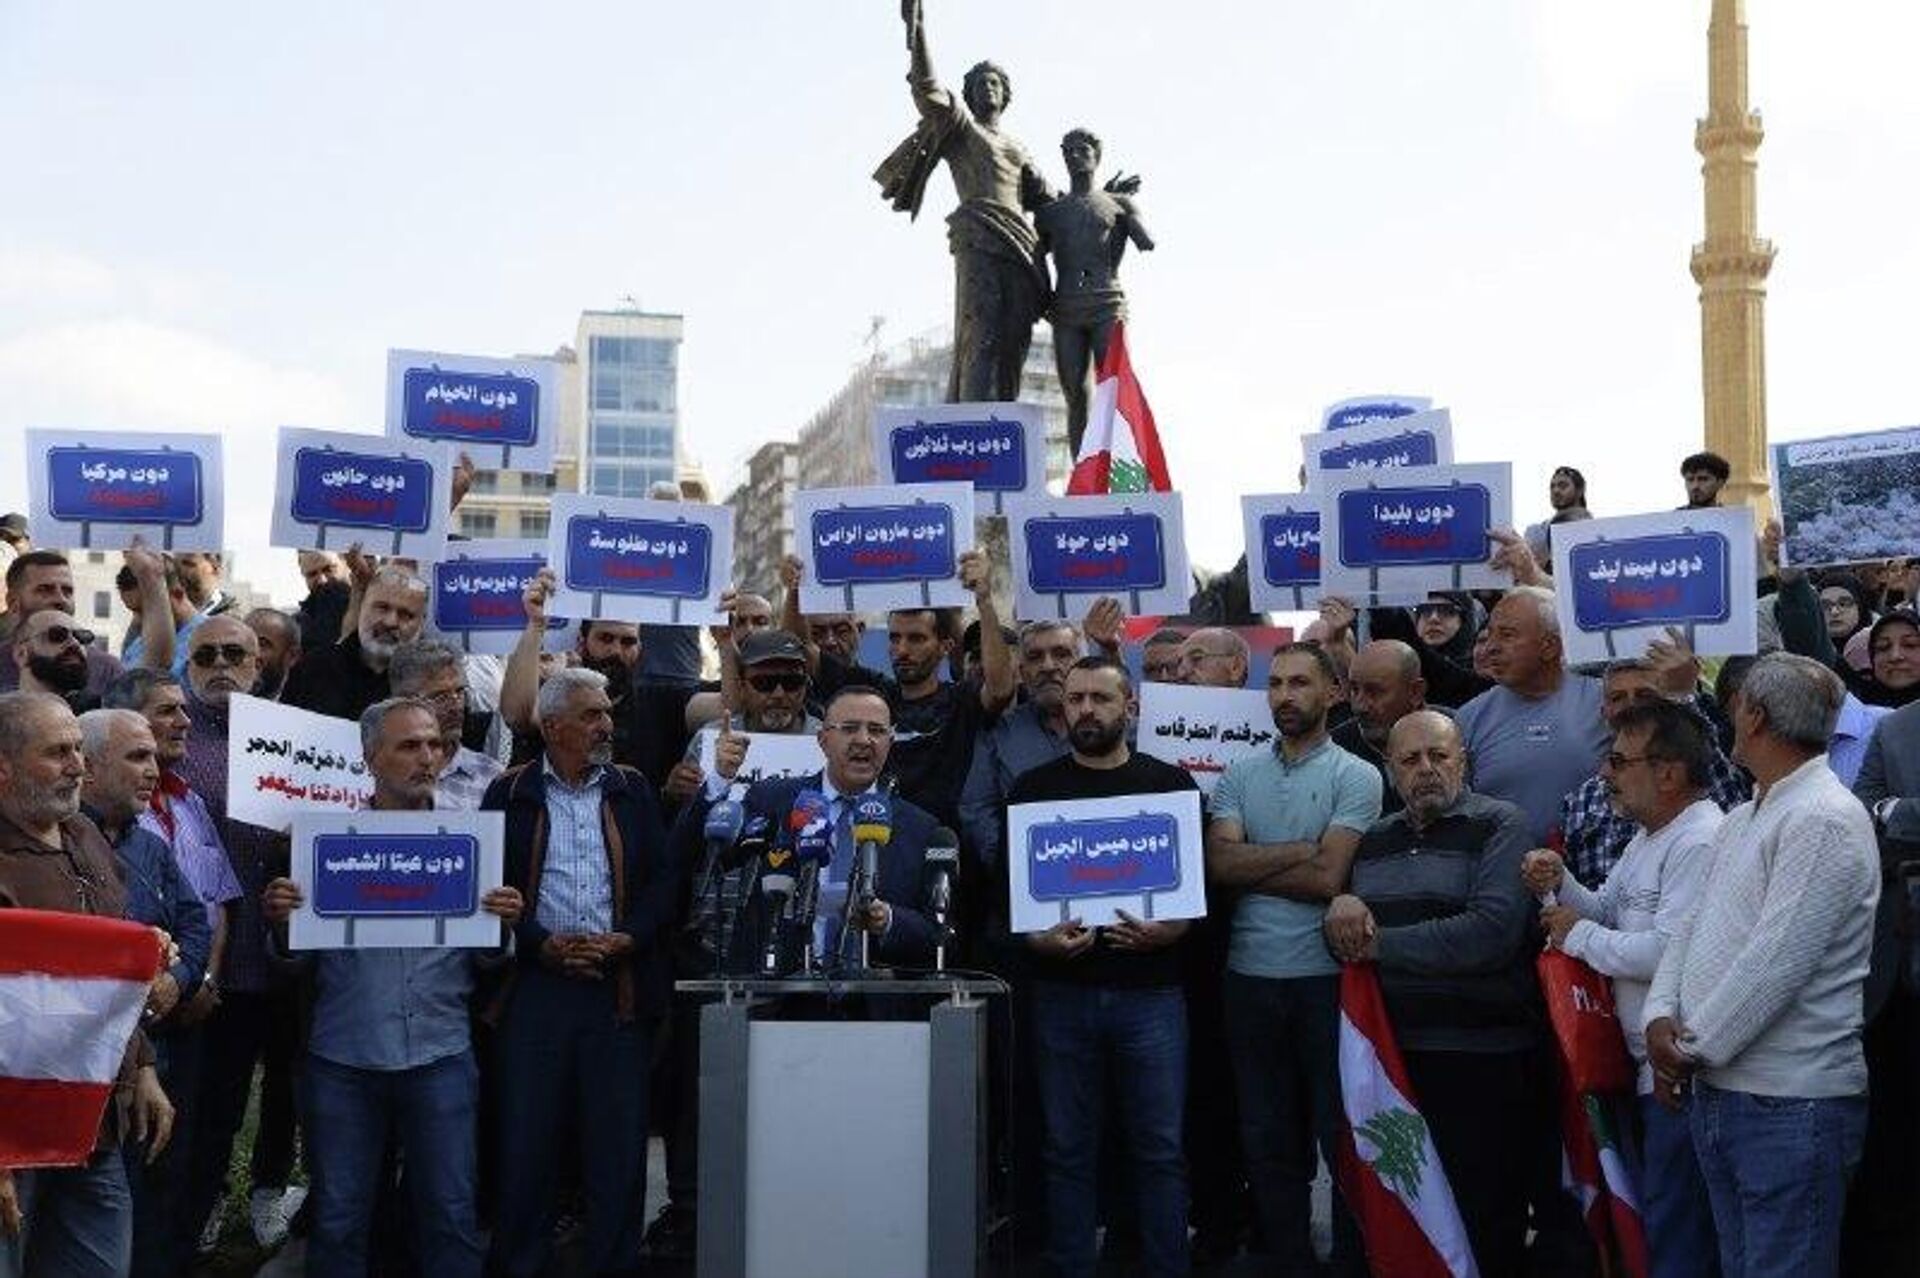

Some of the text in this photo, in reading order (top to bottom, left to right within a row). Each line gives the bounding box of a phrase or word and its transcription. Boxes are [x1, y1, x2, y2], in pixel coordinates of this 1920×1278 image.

[425, 384, 519, 410] دون الخيام
[951, 440, 974, 456] رب
[976, 437, 1011, 456] دون
[81, 462, 170, 485] دون مركبا
[371, 474, 405, 493] دون
[1373, 504, 1456, 525] دون بليدا
[864, 523, 910, 543] مارون
[912, 523, 946, 542] دون
[651, 539, 689, 559] دون
[1055, 533, 1129, 554] دون حولا
[1622, 560, 1657, 580] بيت
[1660, 556, 1703, 578] دون
[246, 737, 291, 758] الحجر
[1035, 833, 1169, 862] دون ميس الجبل
[325, 852, 387, 875] الشعب
[425, 854, 466, 875] دون
